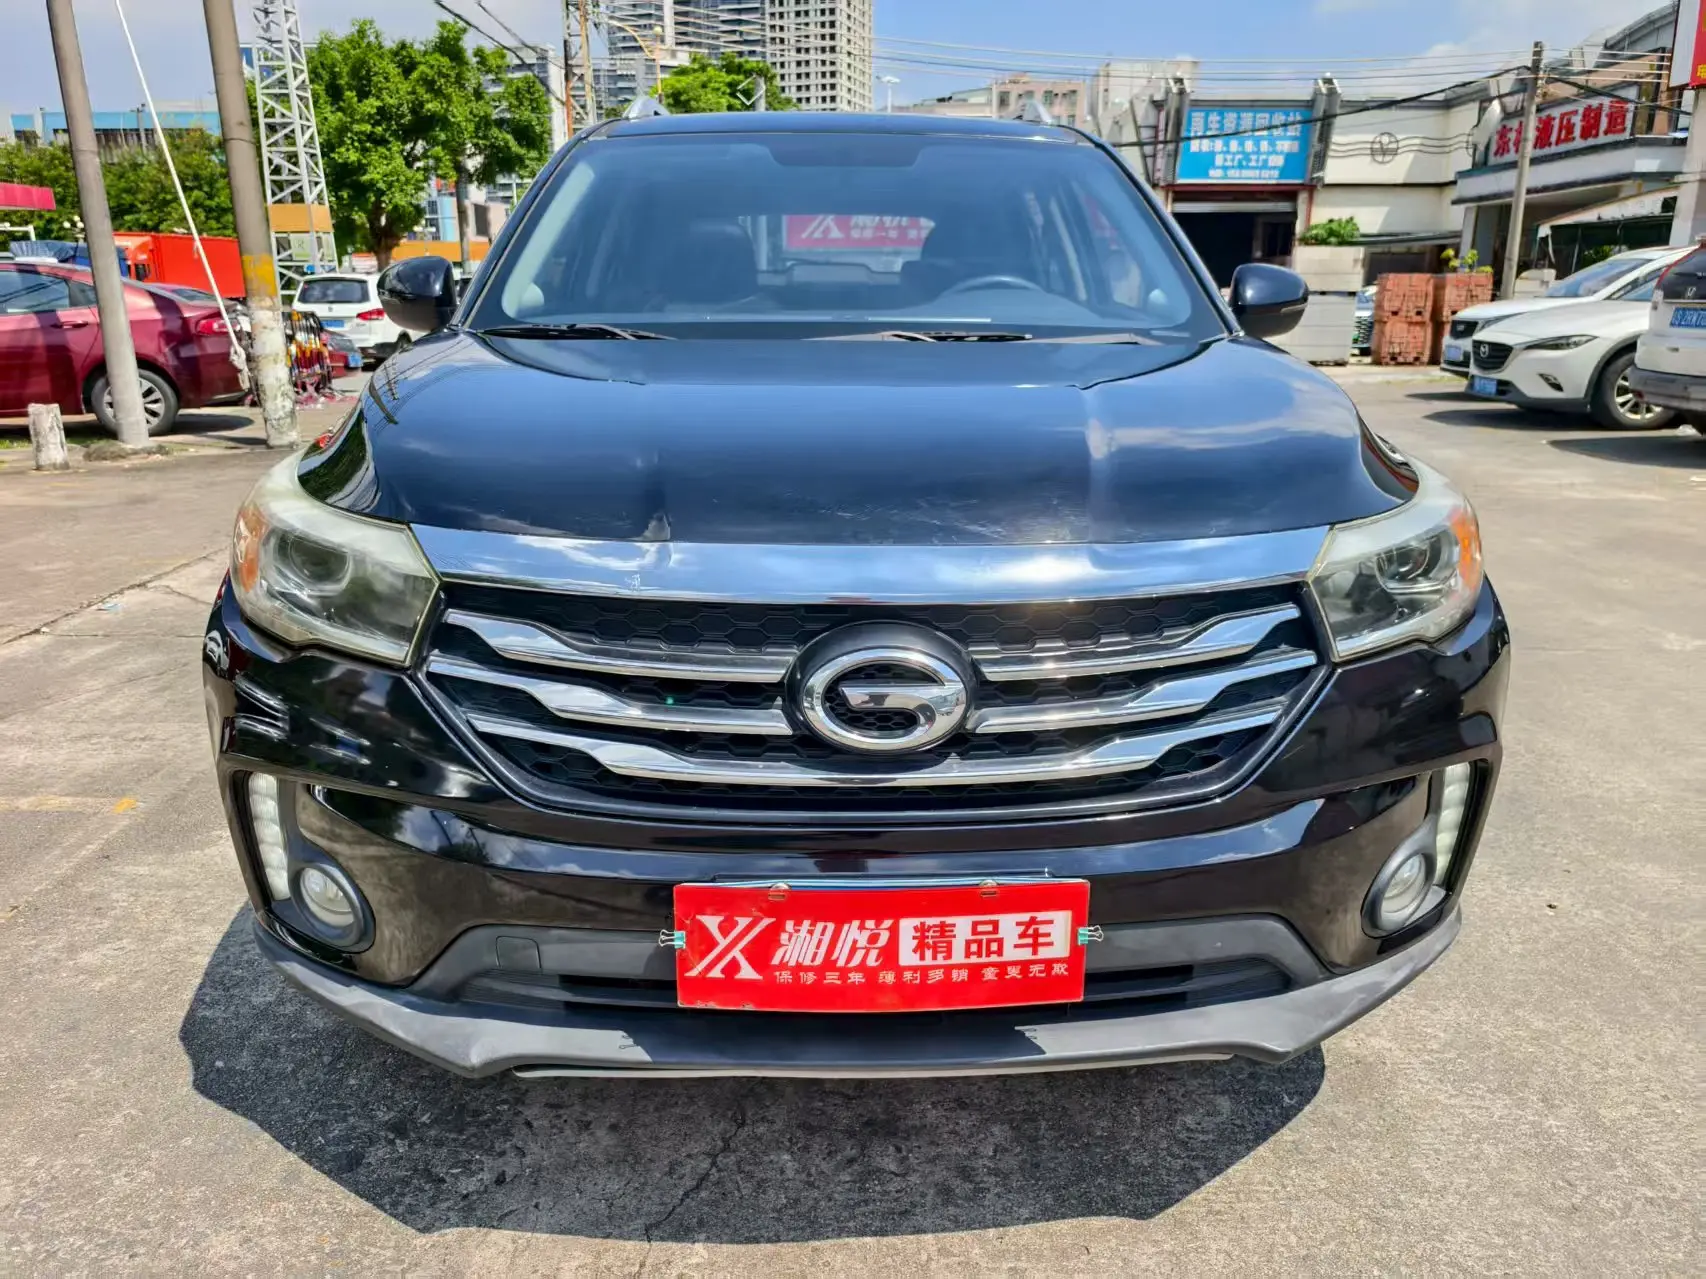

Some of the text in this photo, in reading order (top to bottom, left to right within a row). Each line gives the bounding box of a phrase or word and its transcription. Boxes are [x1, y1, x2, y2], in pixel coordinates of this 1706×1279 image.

[770, 918, 895, 968] 湘悦
[911, 915, 1055, 962] 精品车
[774, 970, 866, 986] 保修三年
[878, 968, 969, 985] 薄利多销
